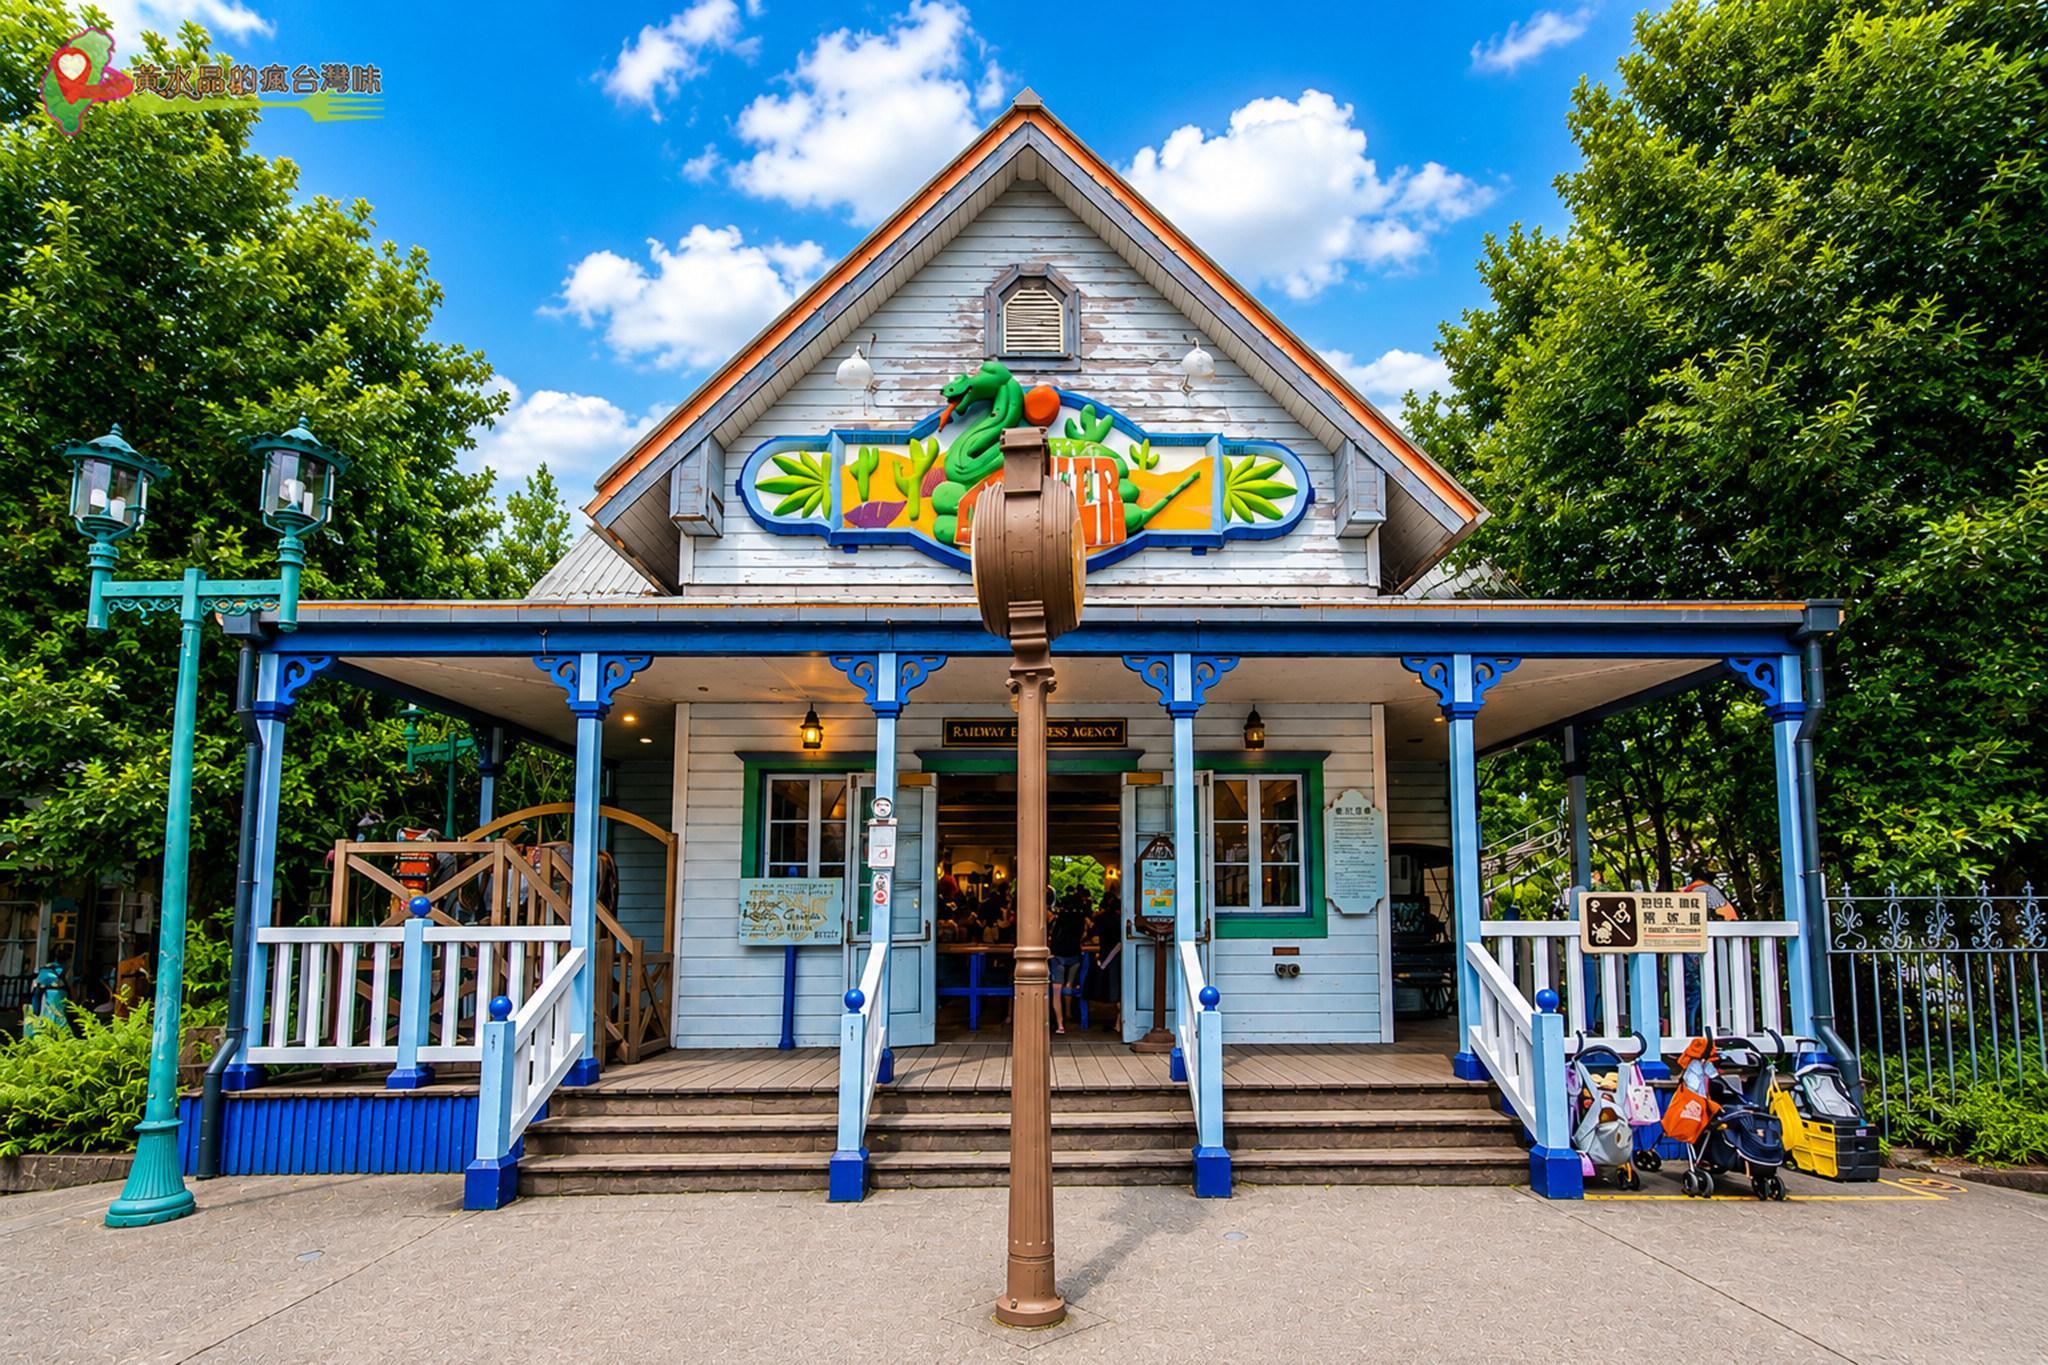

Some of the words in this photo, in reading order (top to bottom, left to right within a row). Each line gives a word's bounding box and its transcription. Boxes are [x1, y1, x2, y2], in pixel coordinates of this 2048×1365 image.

[953, 726, 1006, 737] RAILWAY
[1011, 726, 1069, 738] EESS
[1072, 726, 1118, 737] AGENCY
